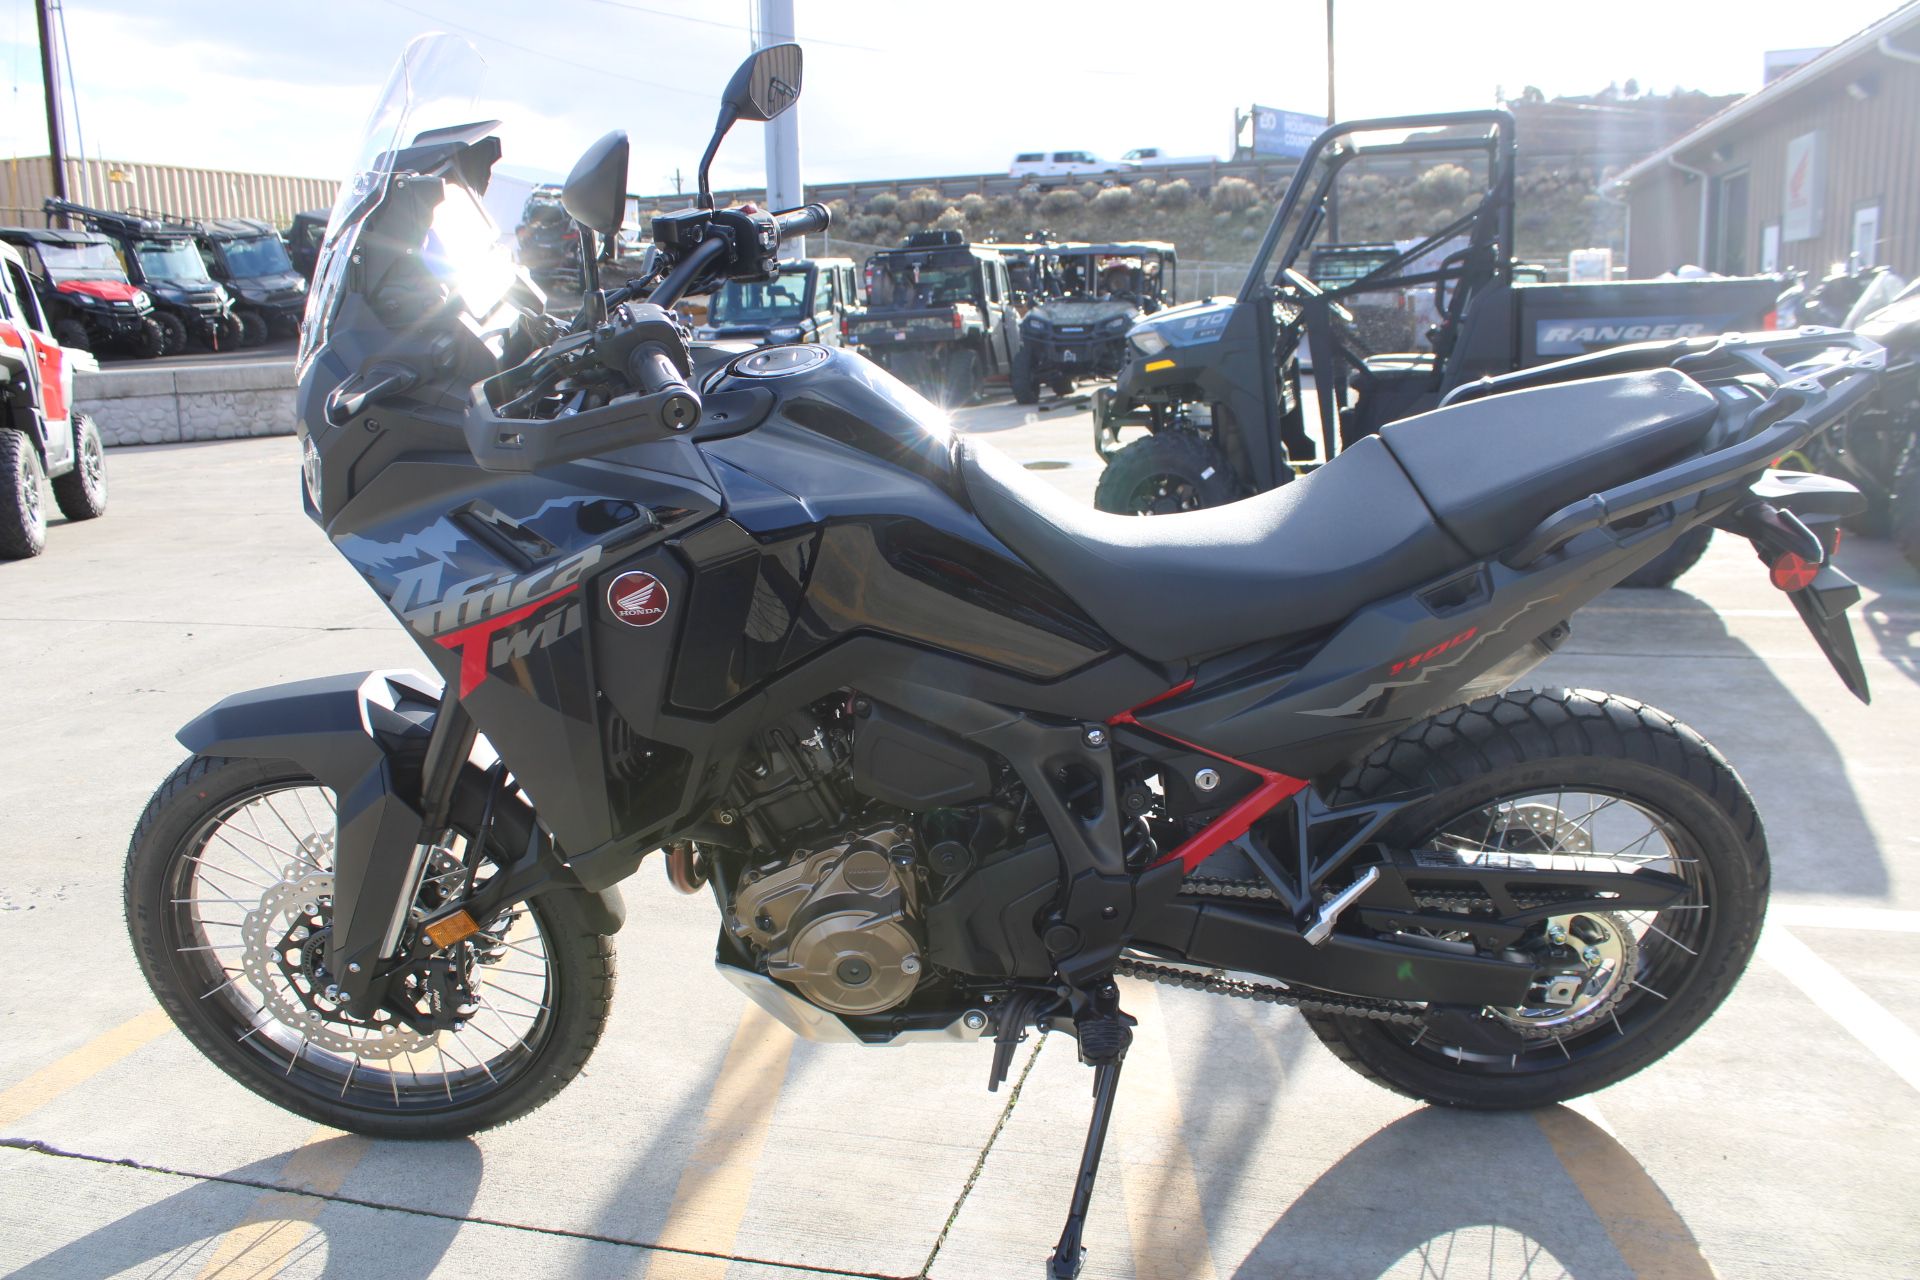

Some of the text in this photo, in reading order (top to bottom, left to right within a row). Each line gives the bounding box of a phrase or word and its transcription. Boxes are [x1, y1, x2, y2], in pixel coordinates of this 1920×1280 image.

[1184, 313, 1225, 330] 570
[1544, 323, 1704, 343] RANGER
[389, 544, 603, 636] Africa
[619, 607, 662, 617] HONDA
[1390, 626, 1477, 675] 1100
